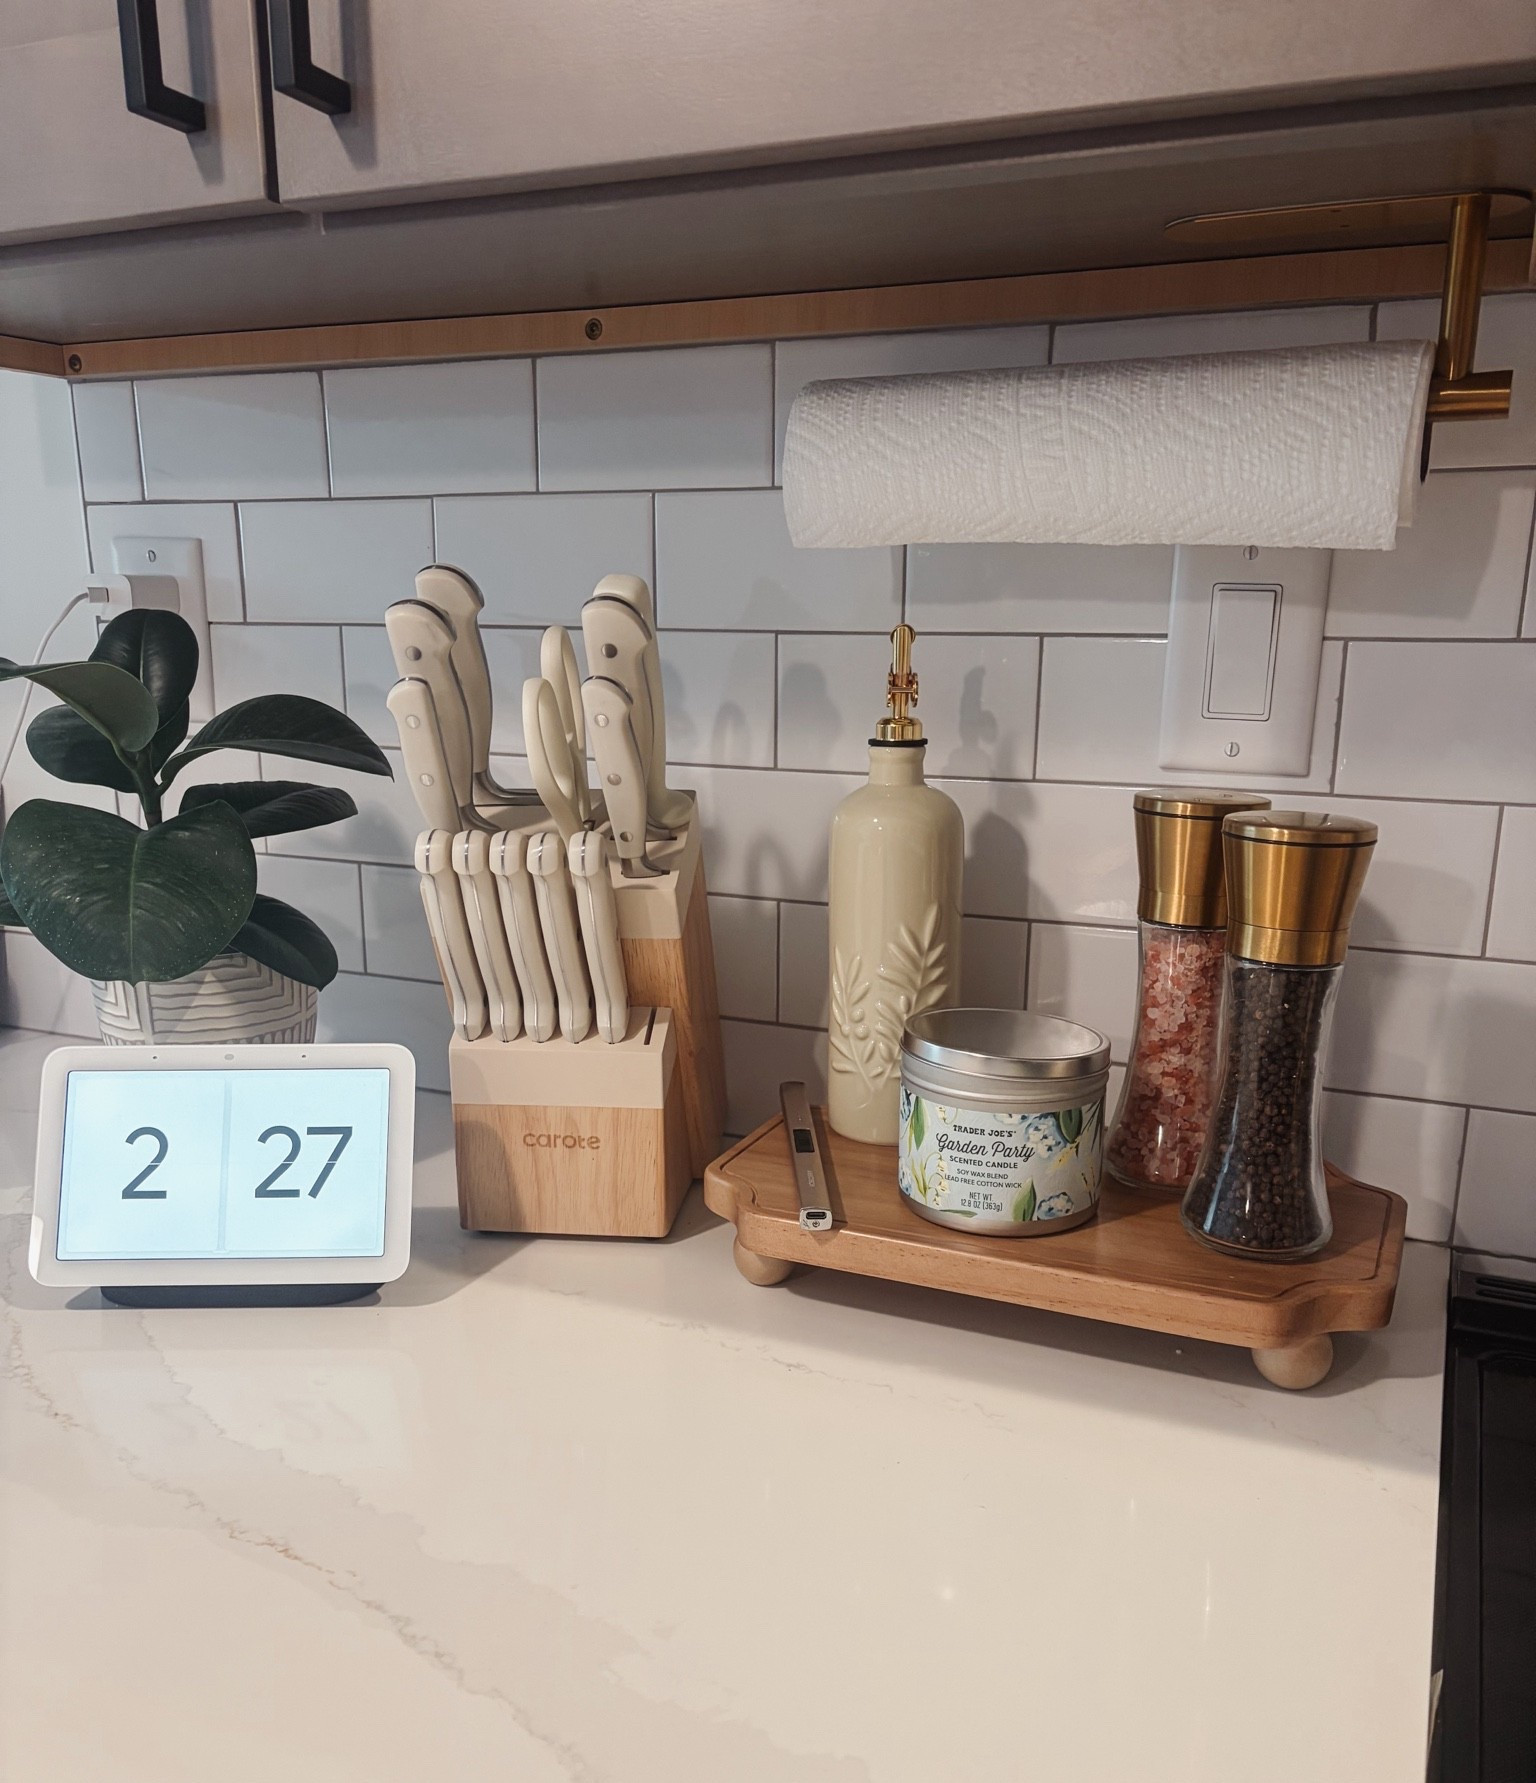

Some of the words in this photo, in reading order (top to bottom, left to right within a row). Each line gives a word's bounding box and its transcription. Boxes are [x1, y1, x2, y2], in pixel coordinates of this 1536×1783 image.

[953, 1124, 986, 1136] TRADER
[522, 1132, 601, 1150] carote
[936, 1133, 988, 1156] Garden
[992, 1141, 1035, 1162] Party
[121, 1126, 169, 1200] 2
[254, 1125, 353, 1199] 27
[949, 1155, 984, 1167] SCENTED
[985, 1161, 1019, 1169] CANDLE
[944, 1173, 960, 1183] LEAD
[960, 1177, 976, 1186] FREE
[976, 1180, 1004, 1189] COTTON
[956, 1168, 970, 1176] SOY
[970, 1171, 986, 1179] WAX
[986, 1172, 1009, 1180] BLEND
[969, 1191, 981, 1200] NET
[973, 1200, 981, 1209] OZ
